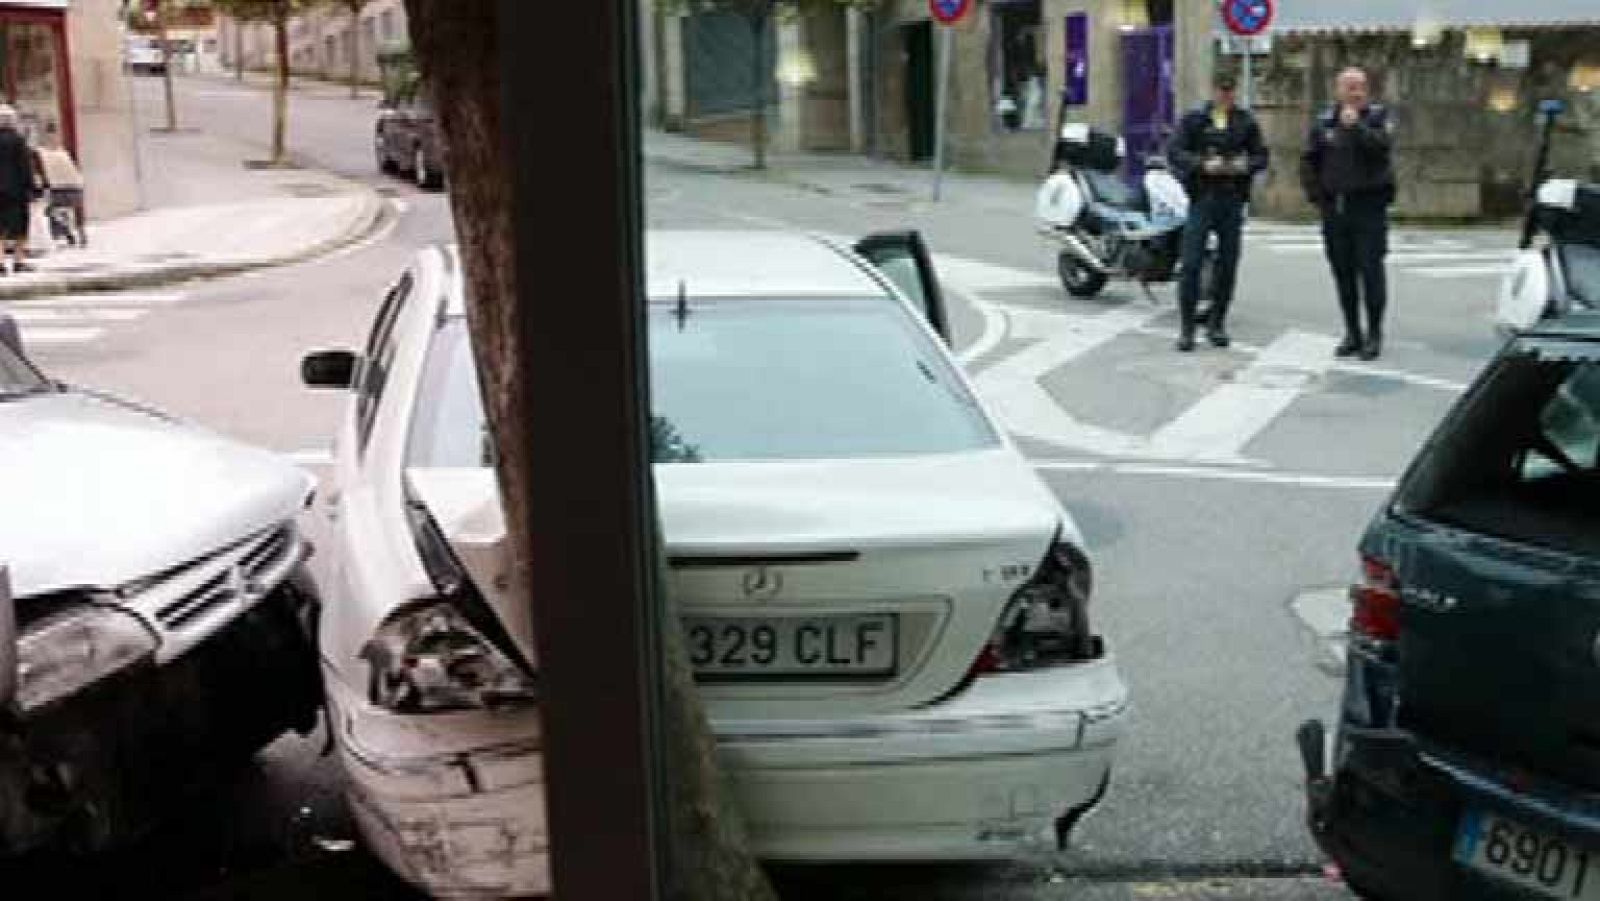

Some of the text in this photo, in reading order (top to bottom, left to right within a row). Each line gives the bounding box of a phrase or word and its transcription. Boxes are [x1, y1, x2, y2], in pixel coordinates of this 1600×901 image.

[689, 621, 884, 665] 329 CLF
[1486, 820, 1587, 898] 6901
